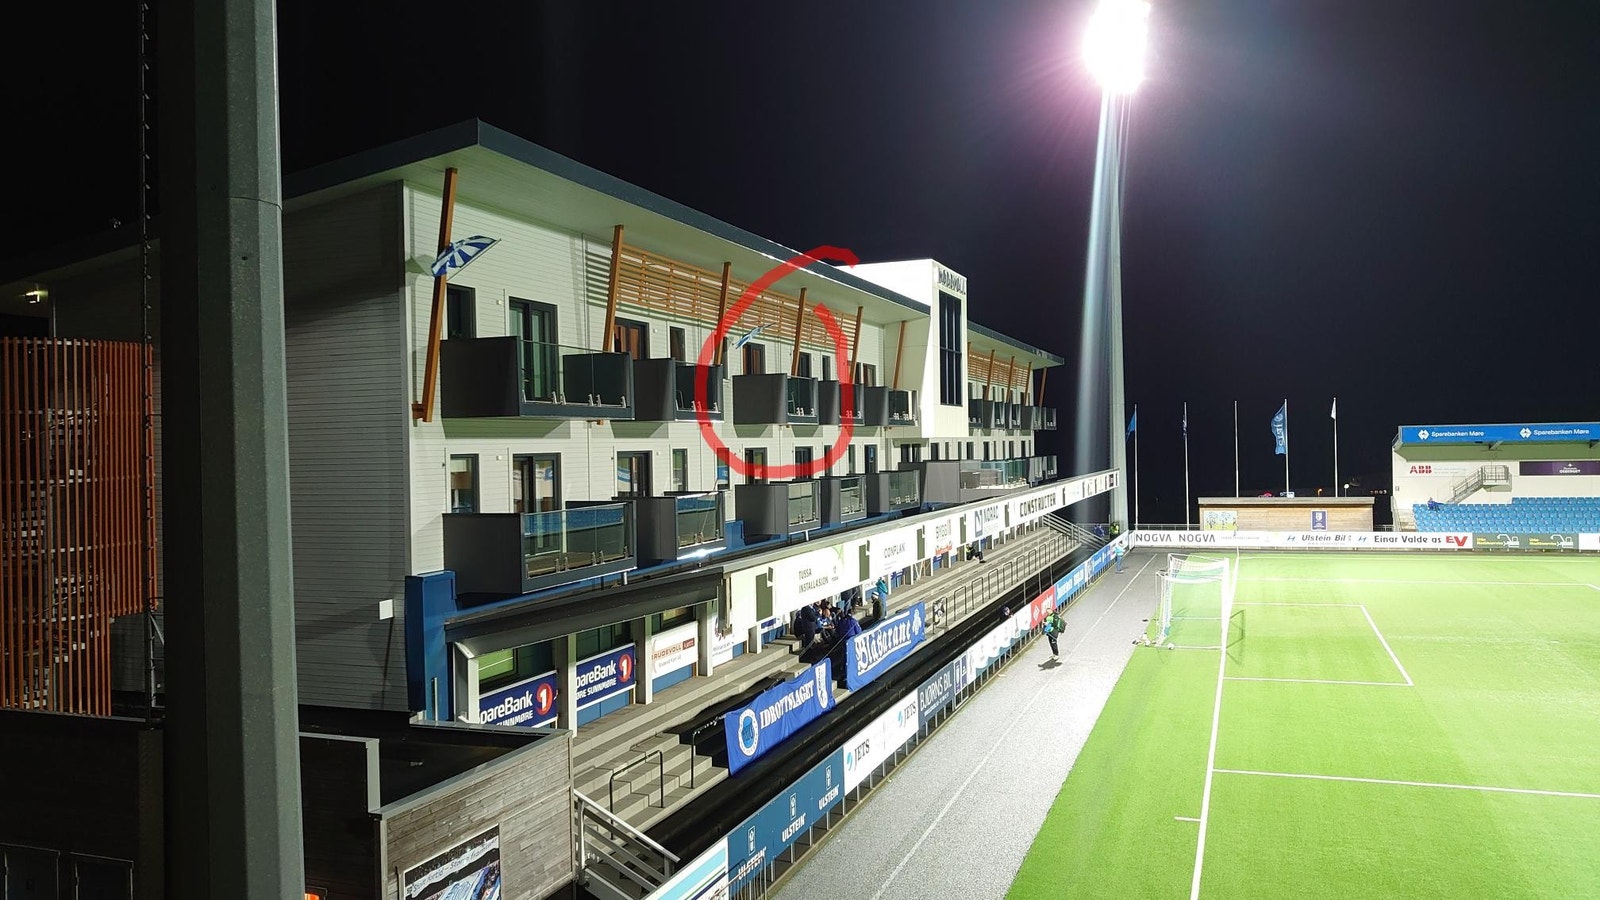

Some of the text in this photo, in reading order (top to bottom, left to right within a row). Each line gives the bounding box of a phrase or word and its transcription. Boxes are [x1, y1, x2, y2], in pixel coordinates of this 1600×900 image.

[1533, 429, 1572, 437] Sparebanken
[1409, 465, 1433, 474] ABB
[1135, 533, 1172, 542] NOGVA
[1178, 534, 1216, 543] NOGVA
[1301, 534, 1331, 542] Ulstein
[1334, 534, 1346, 542] Bil
[1374, 535, 1398, 544] Einar
[1401, 535, 1428, 544] Valde
[1445, 535, 1468, 547] EV
[576, 659, 617, 689] pareBank
[479, 690, 533, 725] pareBank
[759, 679, 815, 730] IDROTTSLAGET
[903, 700, 917, 728] JETS
[854, 738, 870, 771] JETS
[819, 783, 840, 810] ULSTEIN
[782, 812, 807, 843] ULSTEIN
